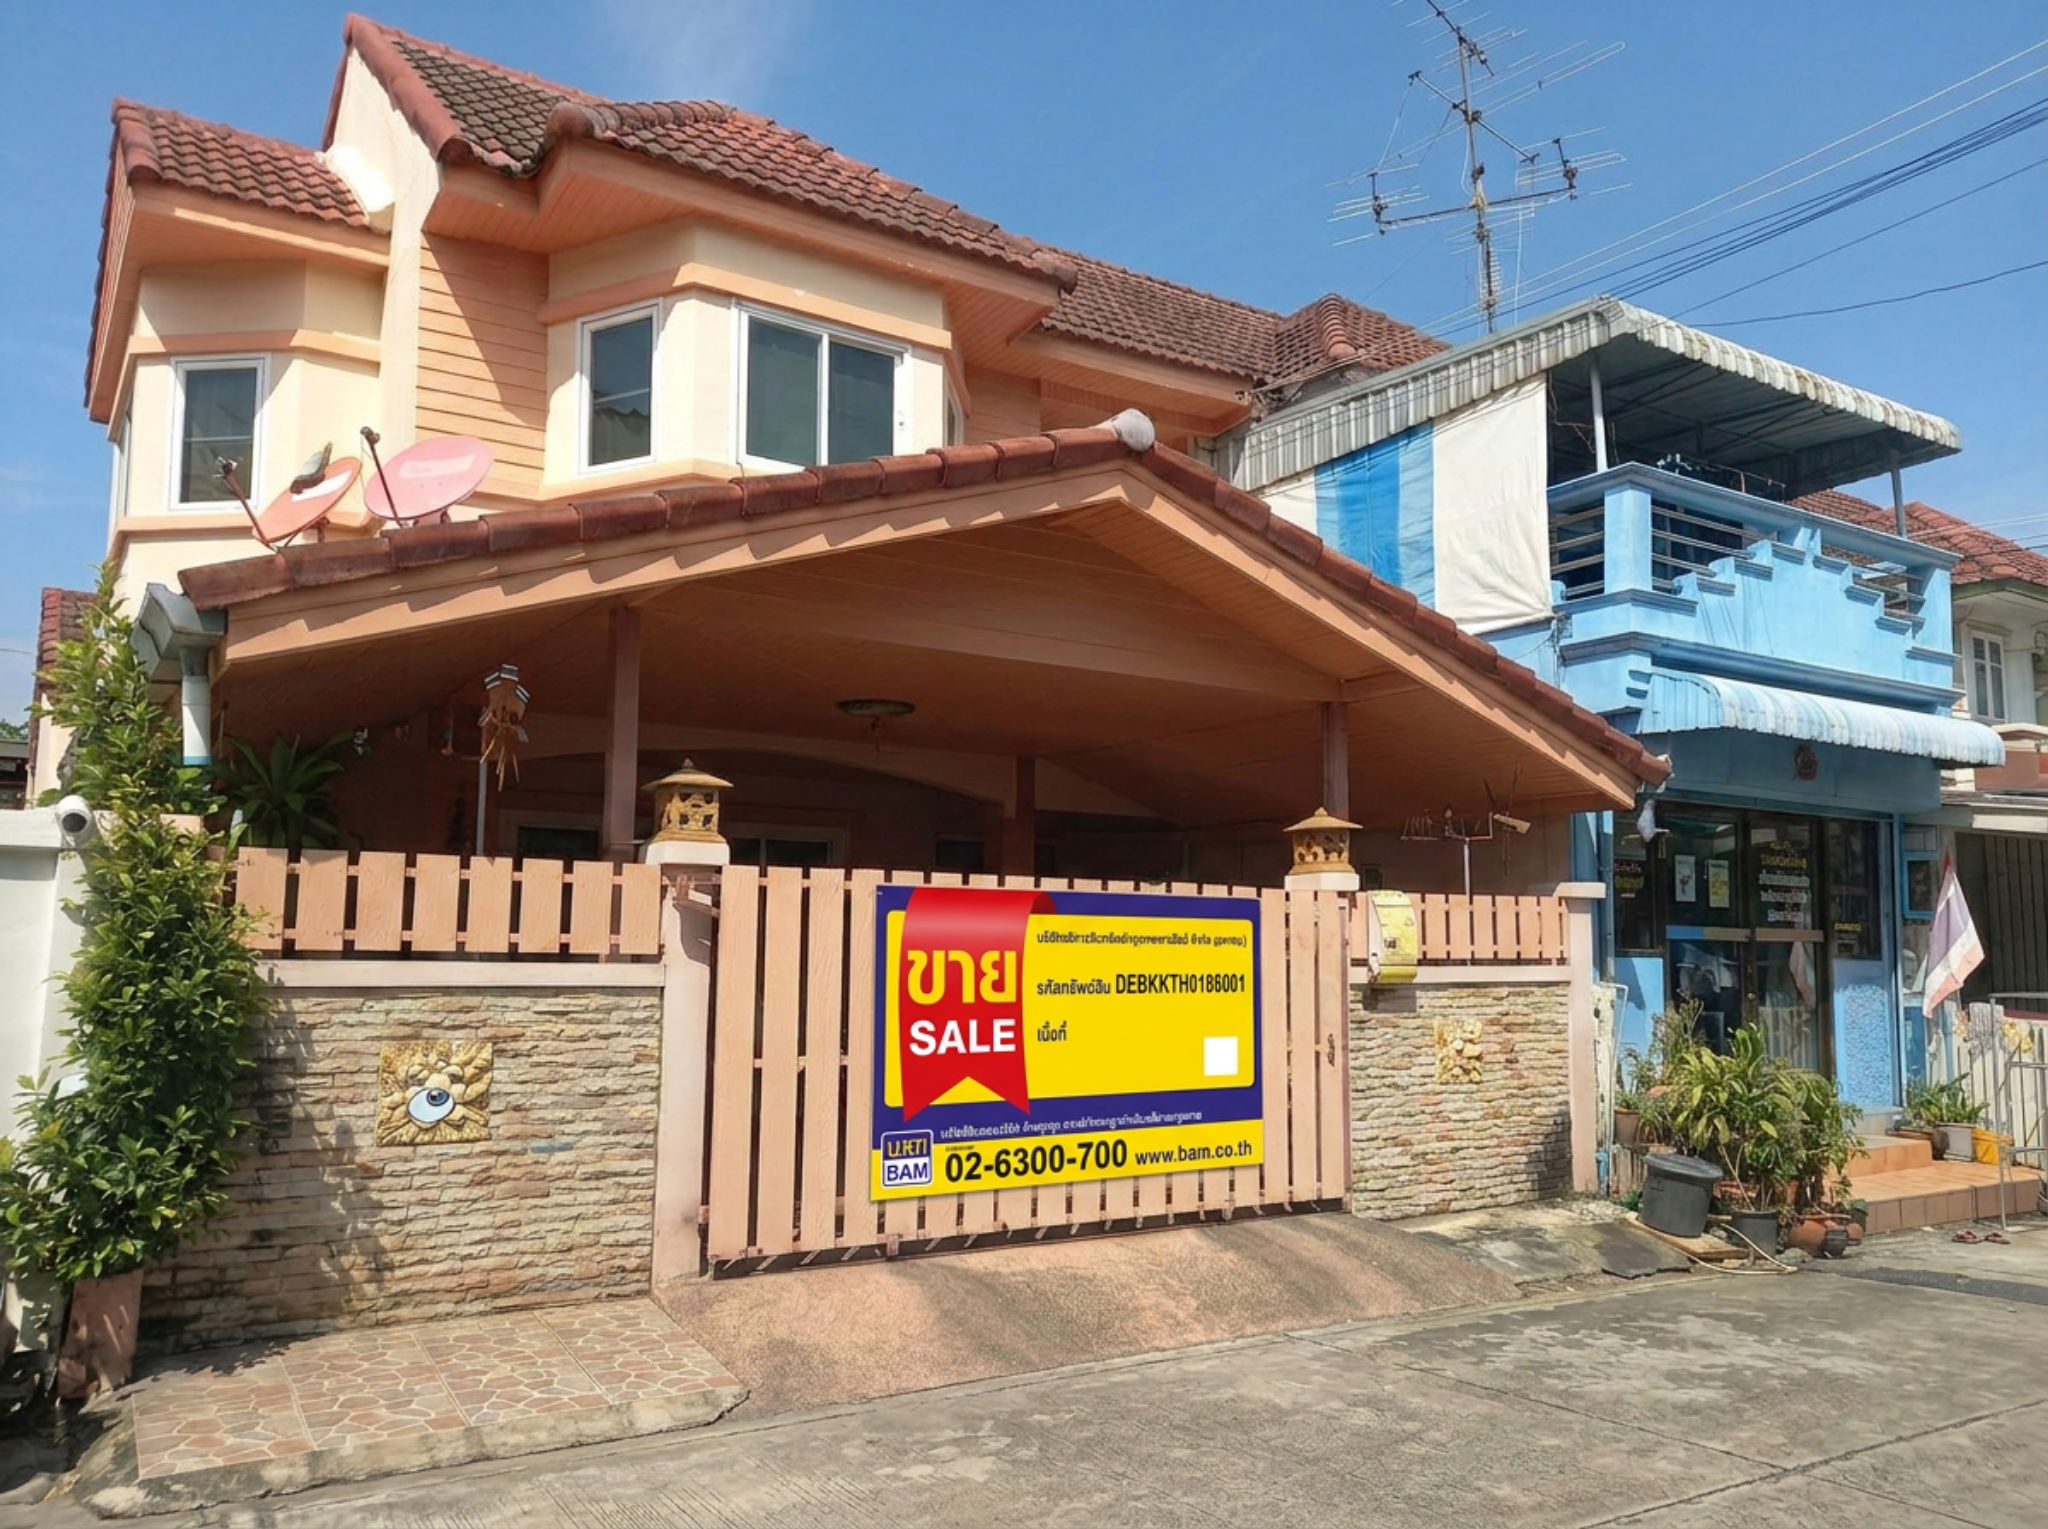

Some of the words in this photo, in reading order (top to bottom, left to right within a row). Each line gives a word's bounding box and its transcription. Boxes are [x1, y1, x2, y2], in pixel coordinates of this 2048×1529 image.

[907, 949, 1017, 1005] ขาย
[909, 1018, 1016, 1056] SALE
[887, 1162, 928, 1181] BAM
[945, 1138, 1128, 1182] 02-6300-700
[1135, 1139, 1252, 1165] www.bam.co.th
